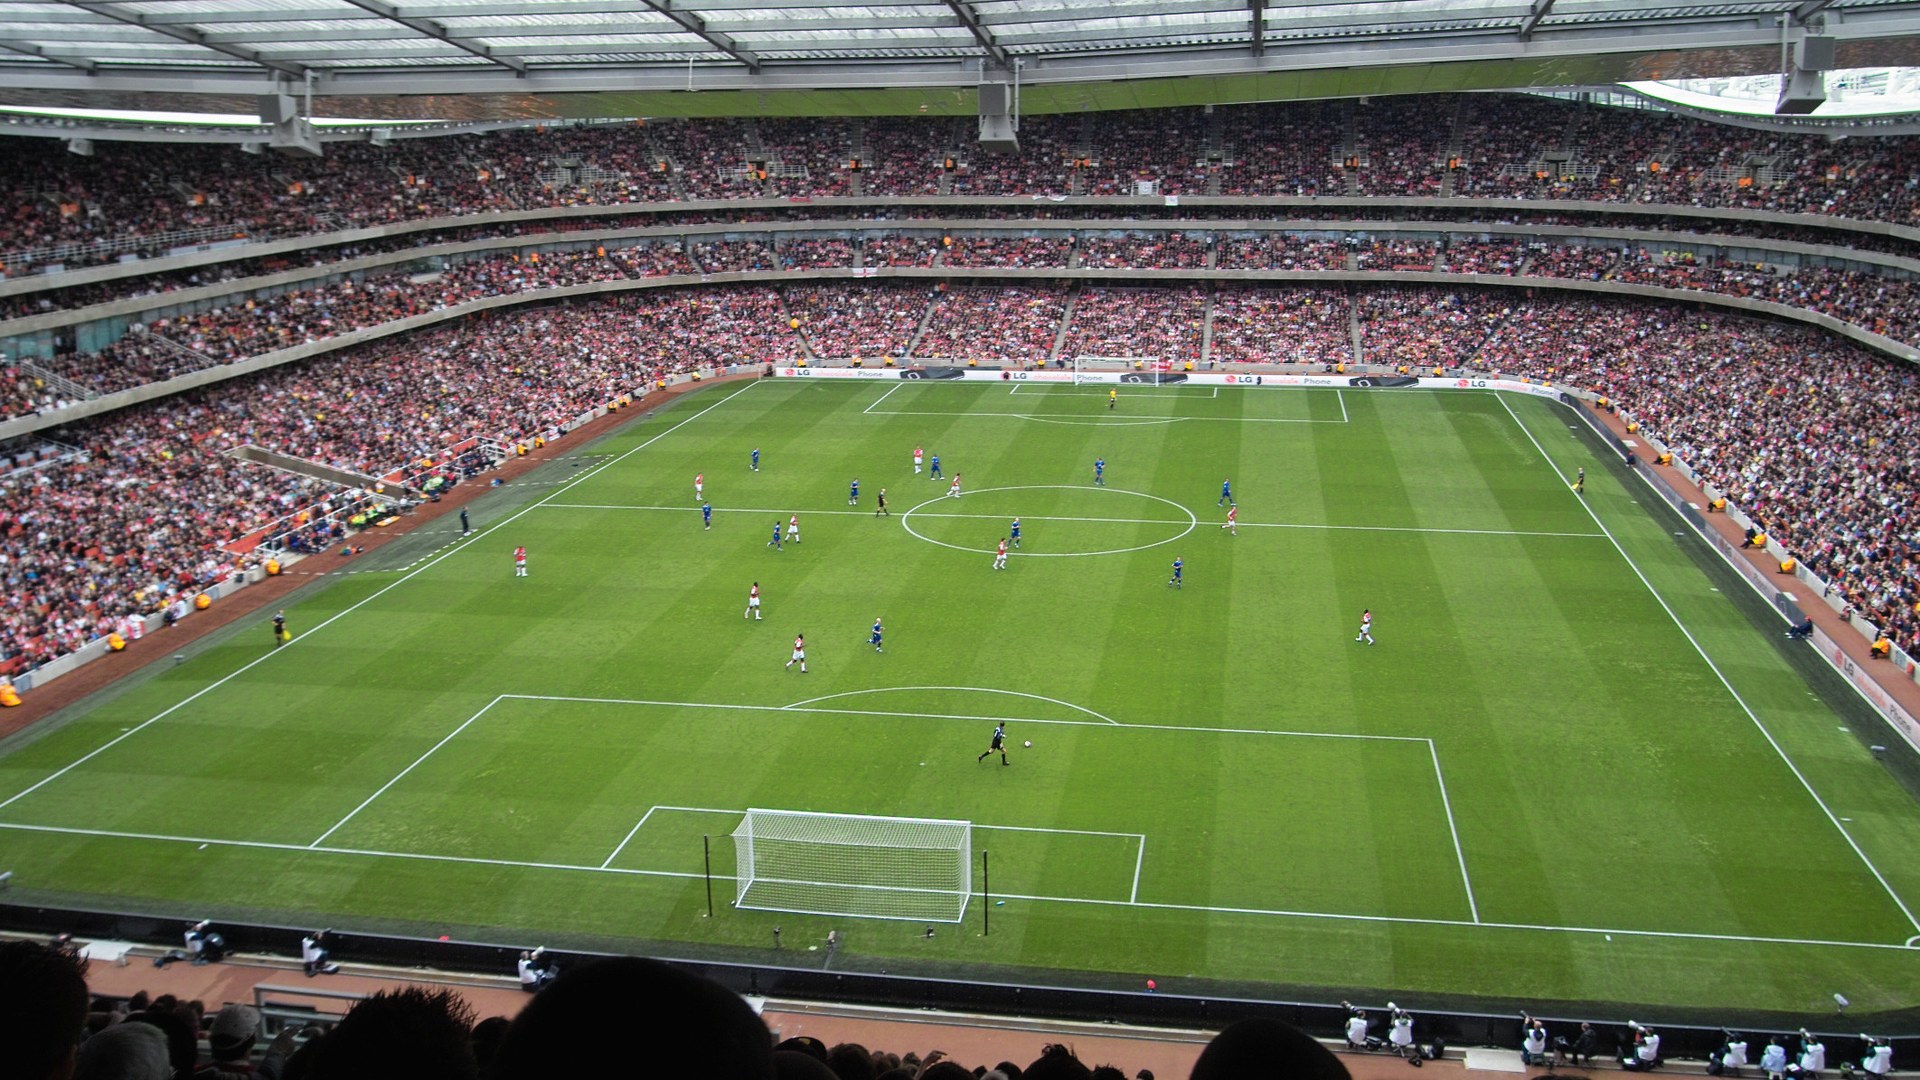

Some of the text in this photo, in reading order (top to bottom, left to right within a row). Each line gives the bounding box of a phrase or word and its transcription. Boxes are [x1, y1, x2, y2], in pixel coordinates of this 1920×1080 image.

[1013, 372, 1027, 380] LG
[1844, 657, 1854, 676] LG
[1890, 704, 1912, 734] Phone
